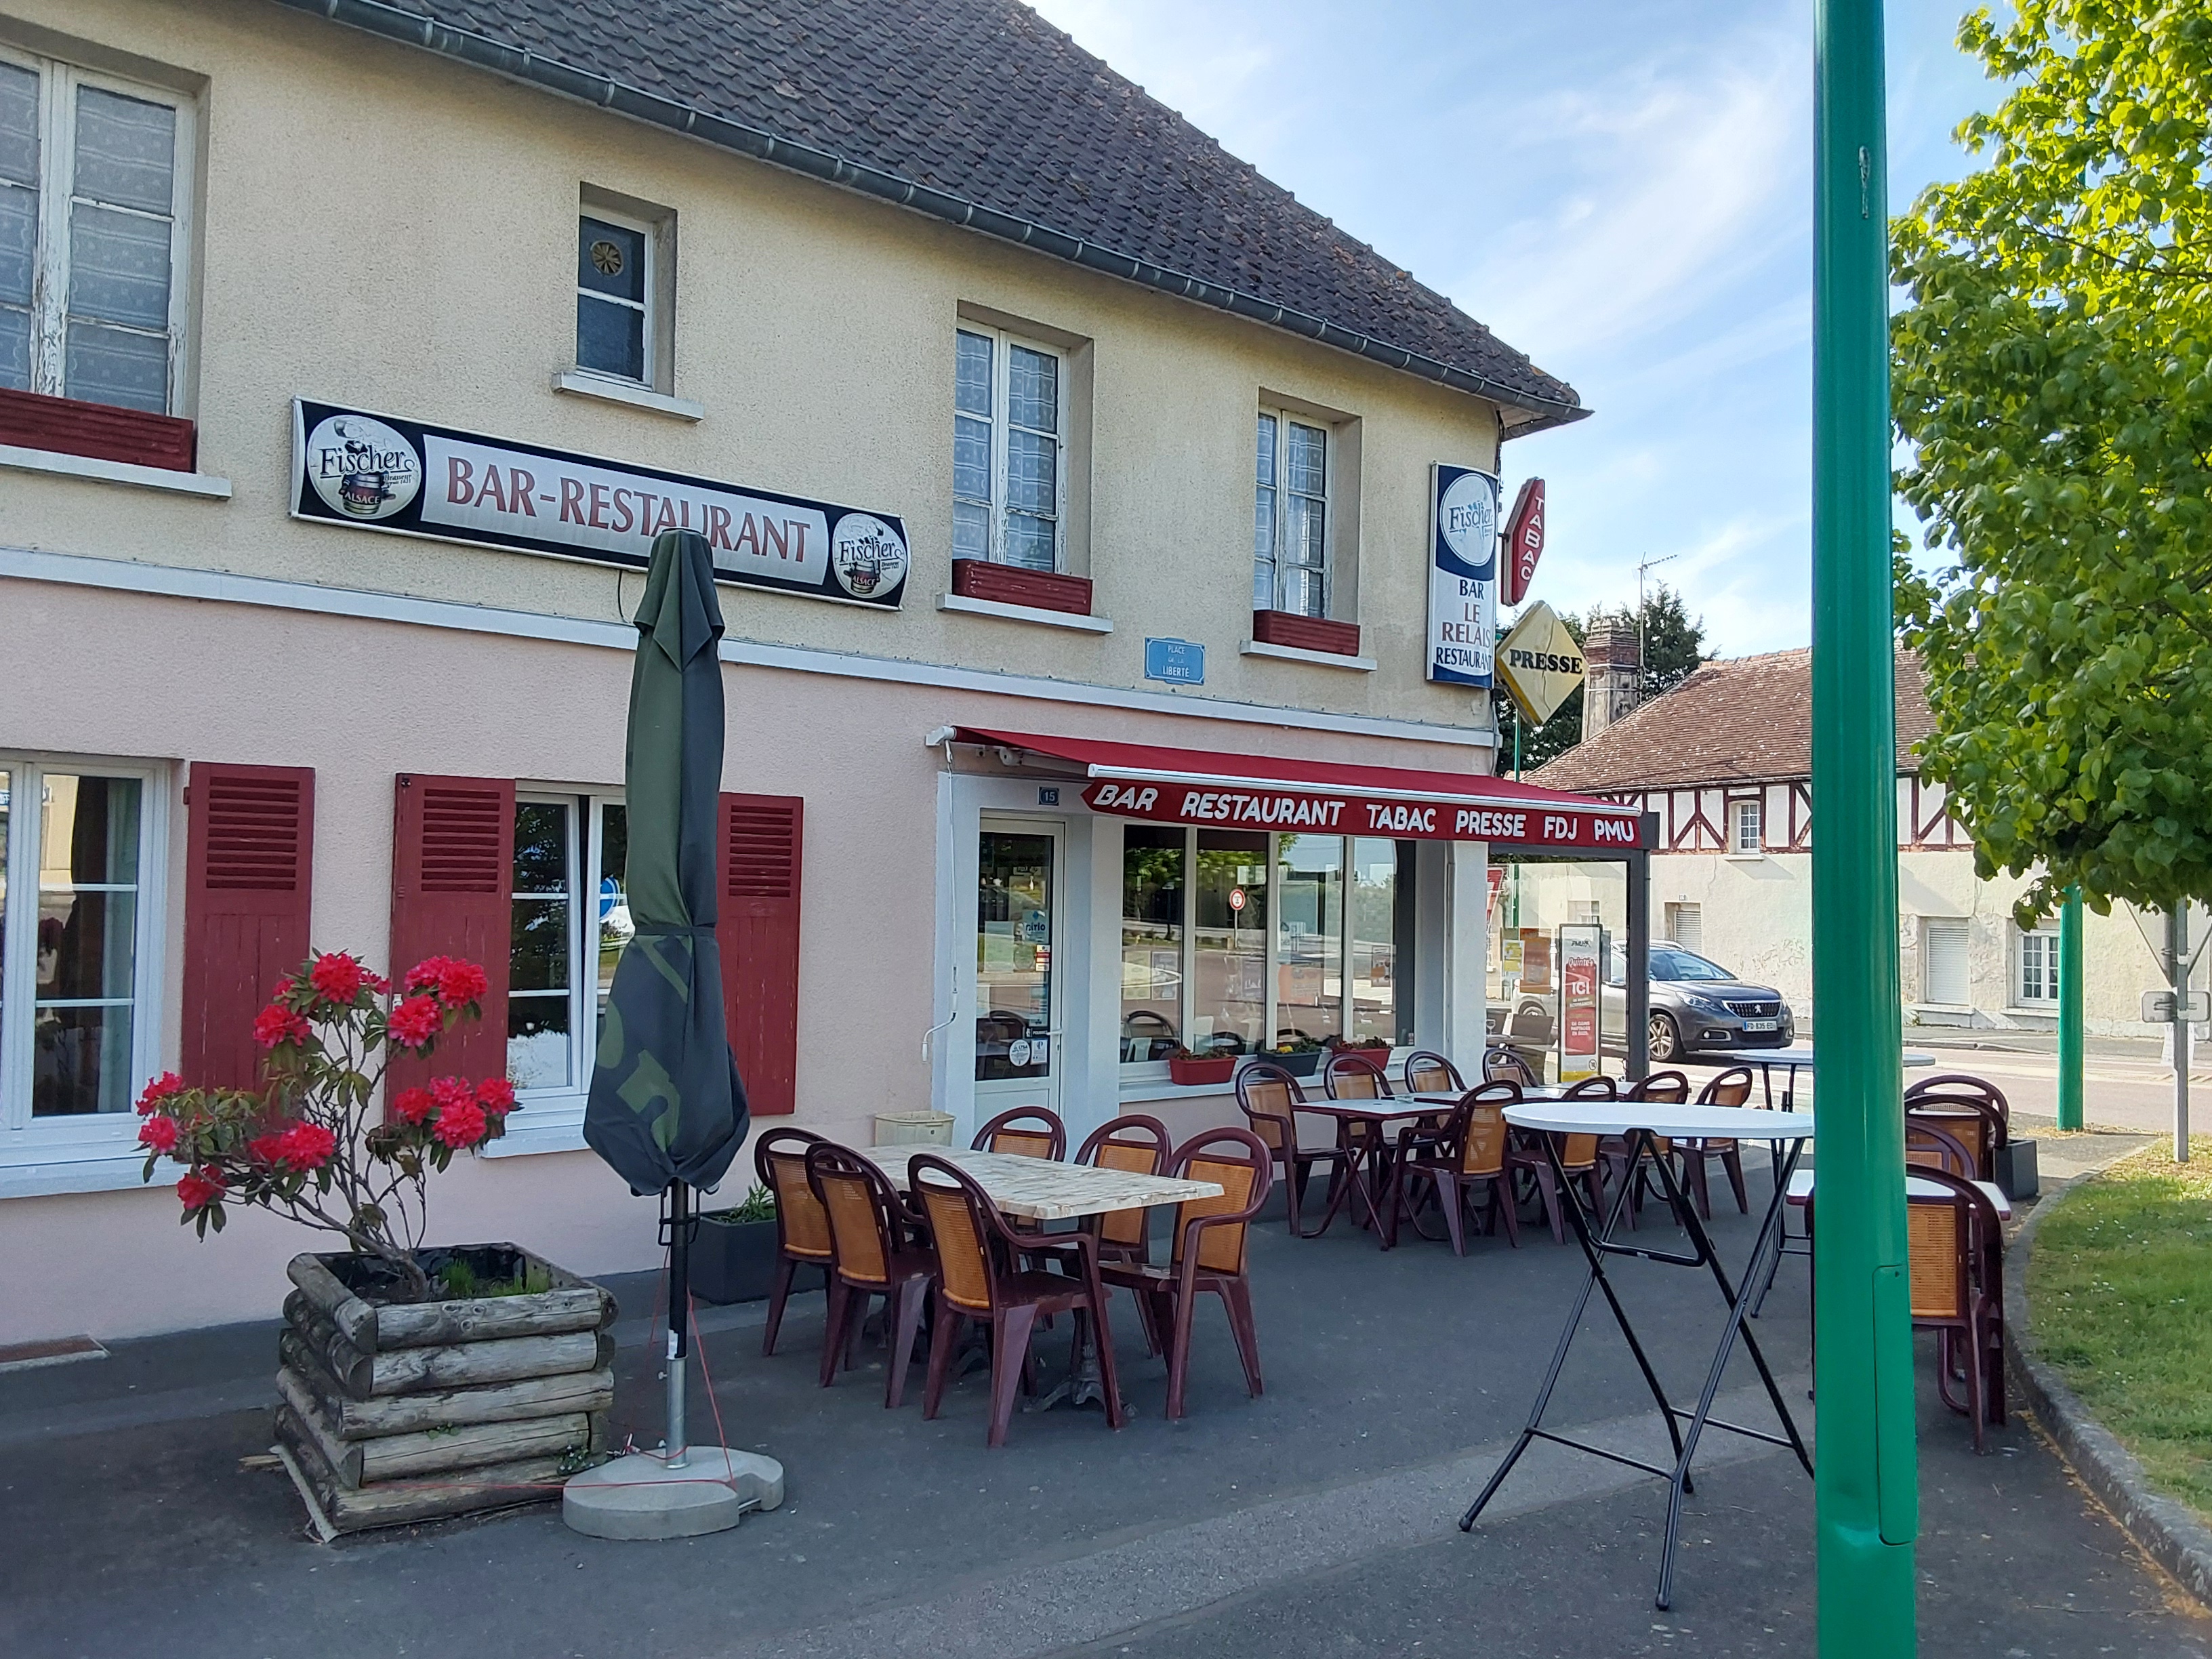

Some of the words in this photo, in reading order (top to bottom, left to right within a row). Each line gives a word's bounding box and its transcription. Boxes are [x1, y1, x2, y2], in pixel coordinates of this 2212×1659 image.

[318, 444, 407, 476] Fischer
[344, 491, 380, 504] ALSACE
[1521, 496, 1544, 581] TABAC
[838, 537, 896, 563] Fischer
[852, 575, 876, 586] ALSACE
[1459, 579, 1484, 600] BAR
[1465, 602, 1481, 624] LE
[1441, 621, 1491, 649] RELAIS
[1168, 644, 1185, 655] PLACE
[1436, 647, 1492, 672] RESTAURANT
[1162, 665, 1189, 678] LIBERTÉ
[1509, 649, 1583, 674] PRESSE
[1044, 791, 1056, 802] 15
[1092, 784, 1159, 811] BAR
[1180, 792, 1346, 826] RESTAURANT
[1366, 804, 1437, 833] TABAC
[1455, 810, 1526, 838] PRESSE
[1543, 815, 1578, 841] FDJ
[1594, 819, 1635, 842] PMU
[1572, 981, 1591, 996] ICI
